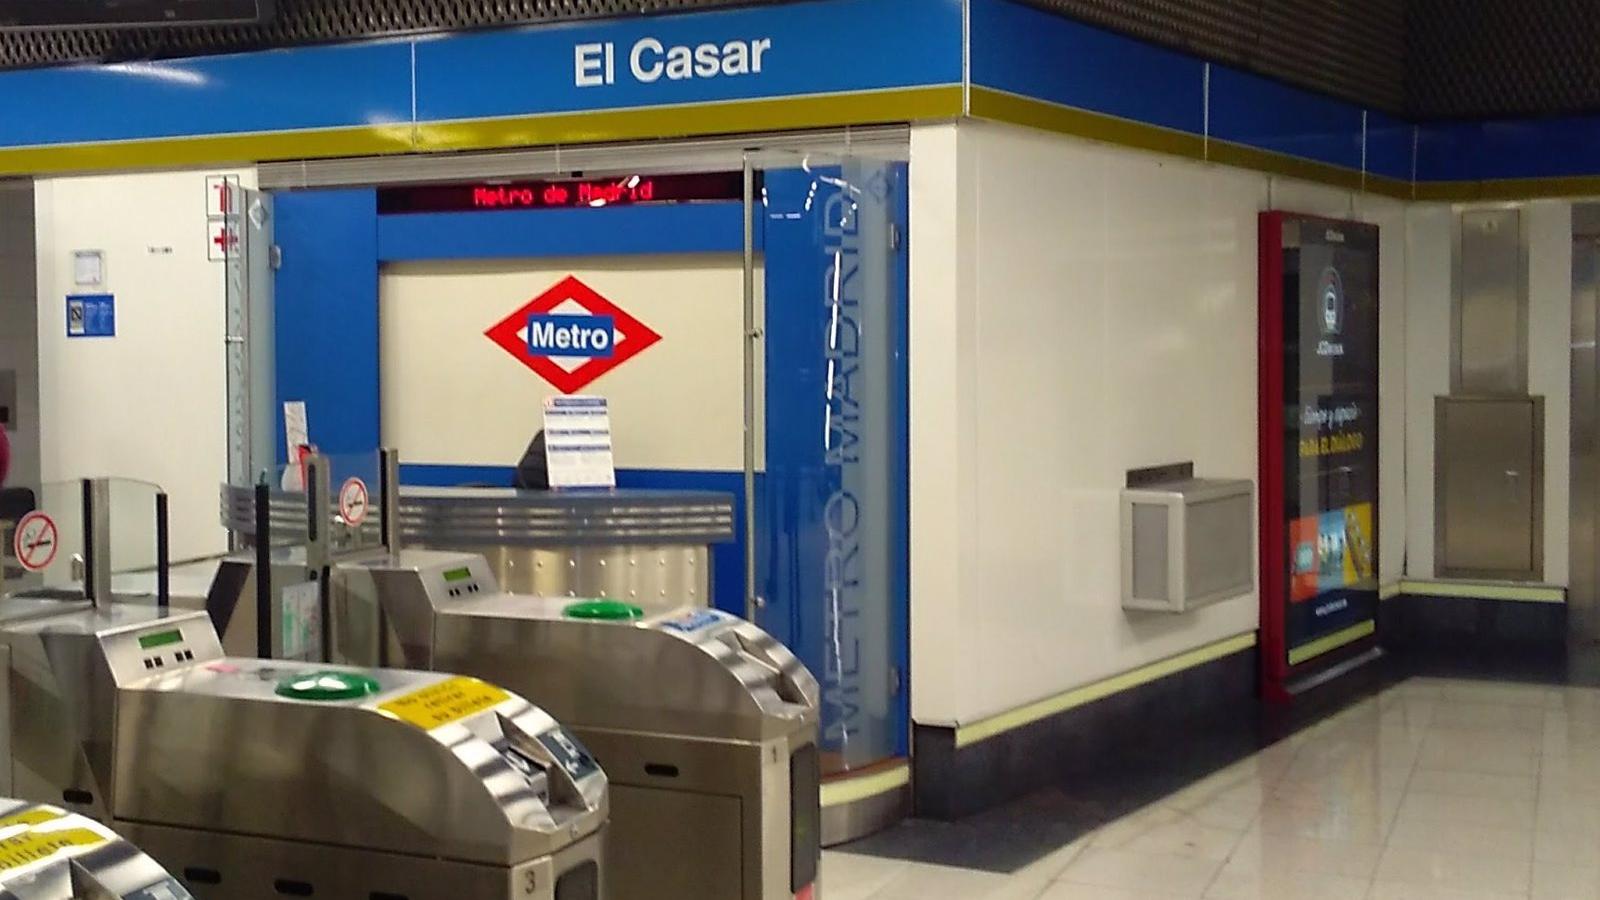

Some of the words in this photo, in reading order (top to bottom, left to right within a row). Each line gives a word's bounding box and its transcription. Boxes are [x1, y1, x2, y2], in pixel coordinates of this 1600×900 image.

[575, 42, 615, 87] El
[630, 37, 770, 83] Casar
[474, 188, 532, 206] Metro
[544, 185, 568, 203] de
[579, 181, 653, 202] Madrid
[532, 321, 609, 350] Metro
[823, 191, 859, 465] MADRID
[823, 490, 859, 739] METRO
[525, 870, 536, 894] 3
